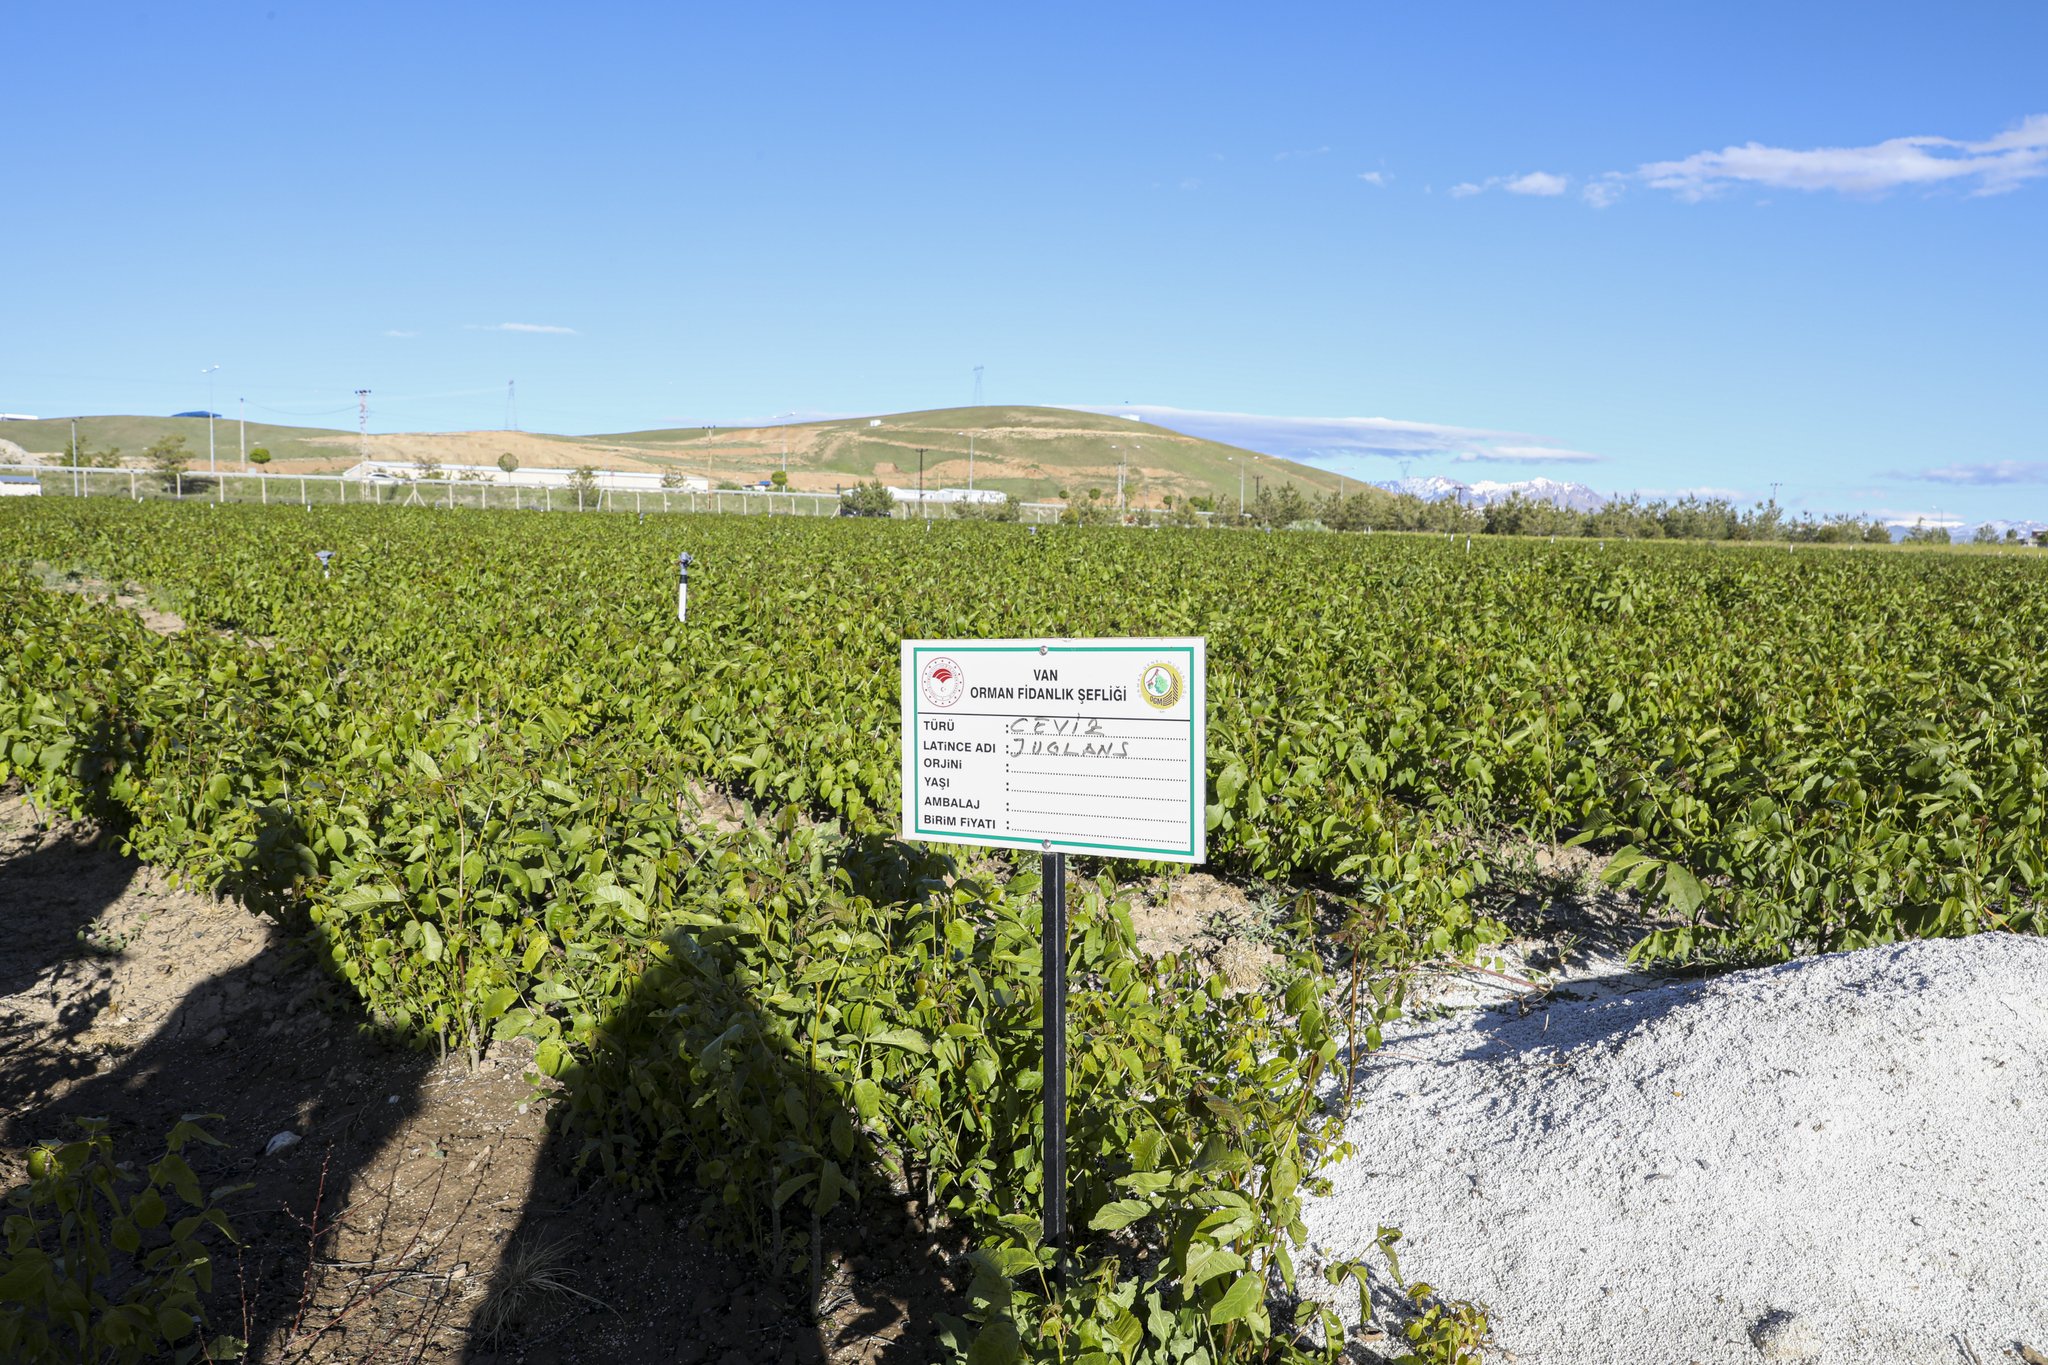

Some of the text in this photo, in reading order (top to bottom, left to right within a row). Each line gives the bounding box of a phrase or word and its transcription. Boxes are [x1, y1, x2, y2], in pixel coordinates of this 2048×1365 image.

[1033, 669, 1058, 681] VAN
[970, 684, 1127, 704] ORMAN FİDANLIK ŞEFLİĞİ
[923, 718, 955, 732] TÜRÜ
[975, 743, 996, 754] ADI
[1010, 738, 1129, 758] JUGLANS
[924, 776, 950, 790] YAŞI
[924, 796, 980, 810] AMBALAJ
